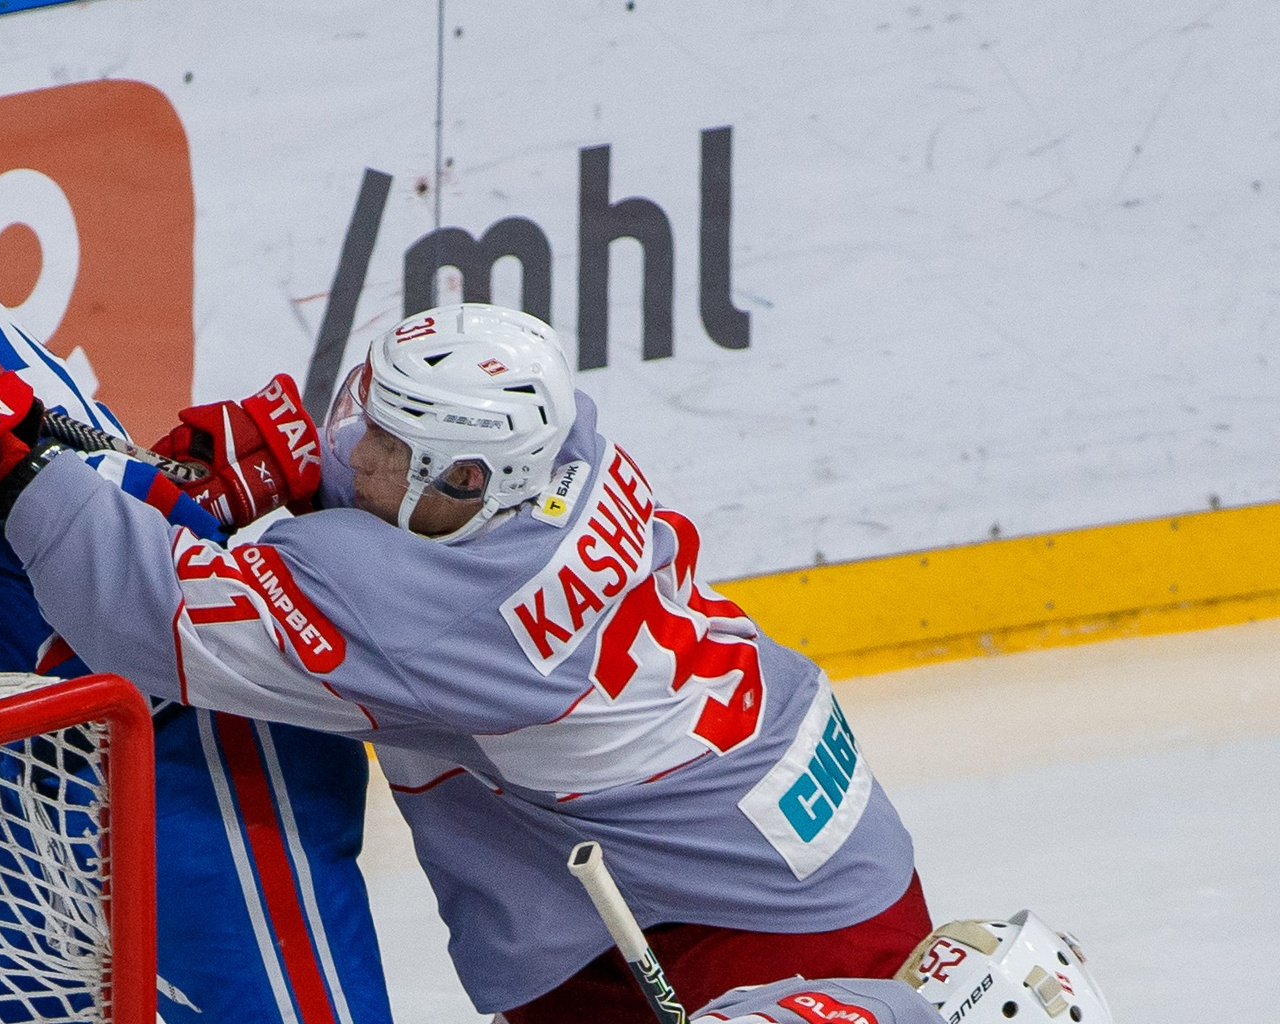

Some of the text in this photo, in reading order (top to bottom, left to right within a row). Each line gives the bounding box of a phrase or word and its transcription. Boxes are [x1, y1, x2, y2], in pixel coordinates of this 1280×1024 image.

[443, 414, 504, 430] BAUER
[556, 464, 580, 497] БАНК
[513, 443, 654, 661] KASHAE
[242, 547, 333, 655] OLIMPBET
[920, 939, 968, 982] 52
